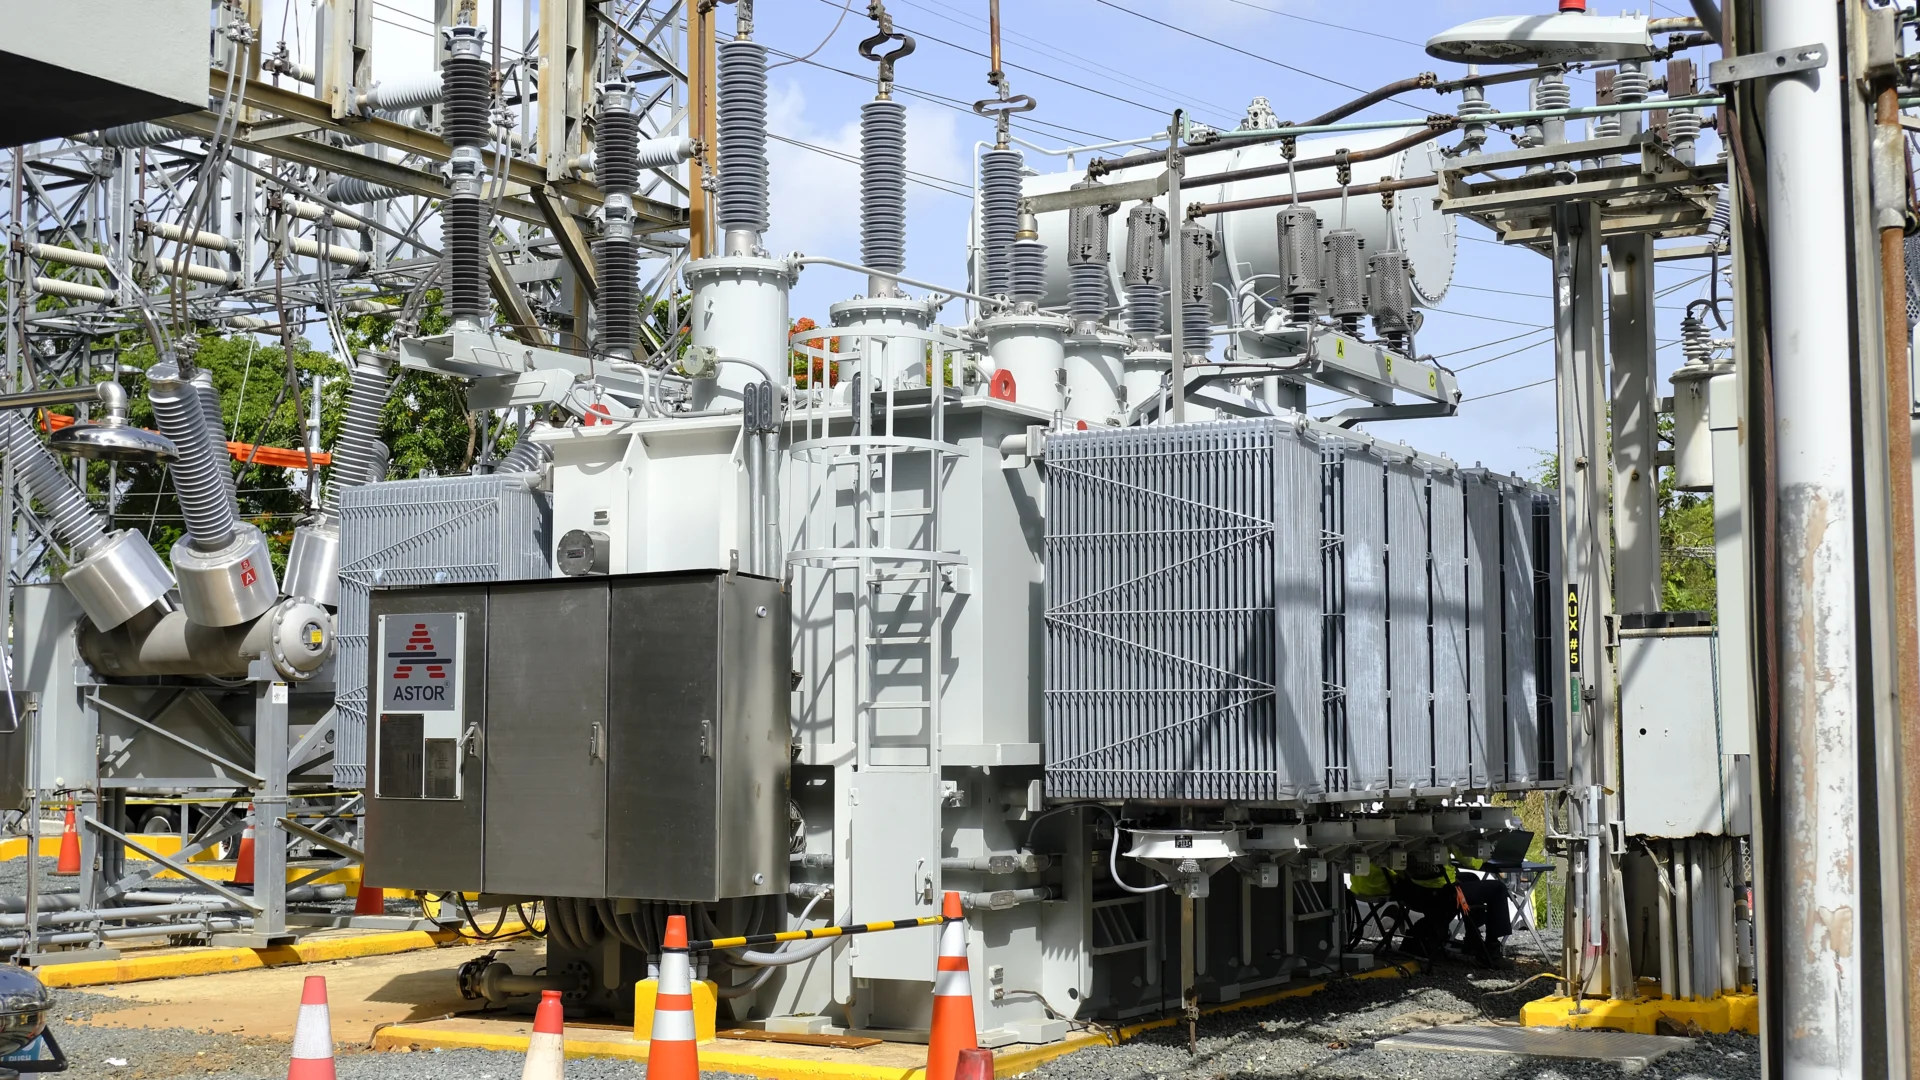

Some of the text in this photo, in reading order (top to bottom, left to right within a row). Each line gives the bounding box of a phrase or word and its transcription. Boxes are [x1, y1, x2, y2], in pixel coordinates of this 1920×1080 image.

[1338, 342, 1343, 356] A
[1386, 359, 1391, 373] B
[1429, 375, 1435, 388] C
[246, 572, 255, 584] A
[1568, 592, 1578, 664] AUX #5
[393, 685, 445, 701] ASTOR
